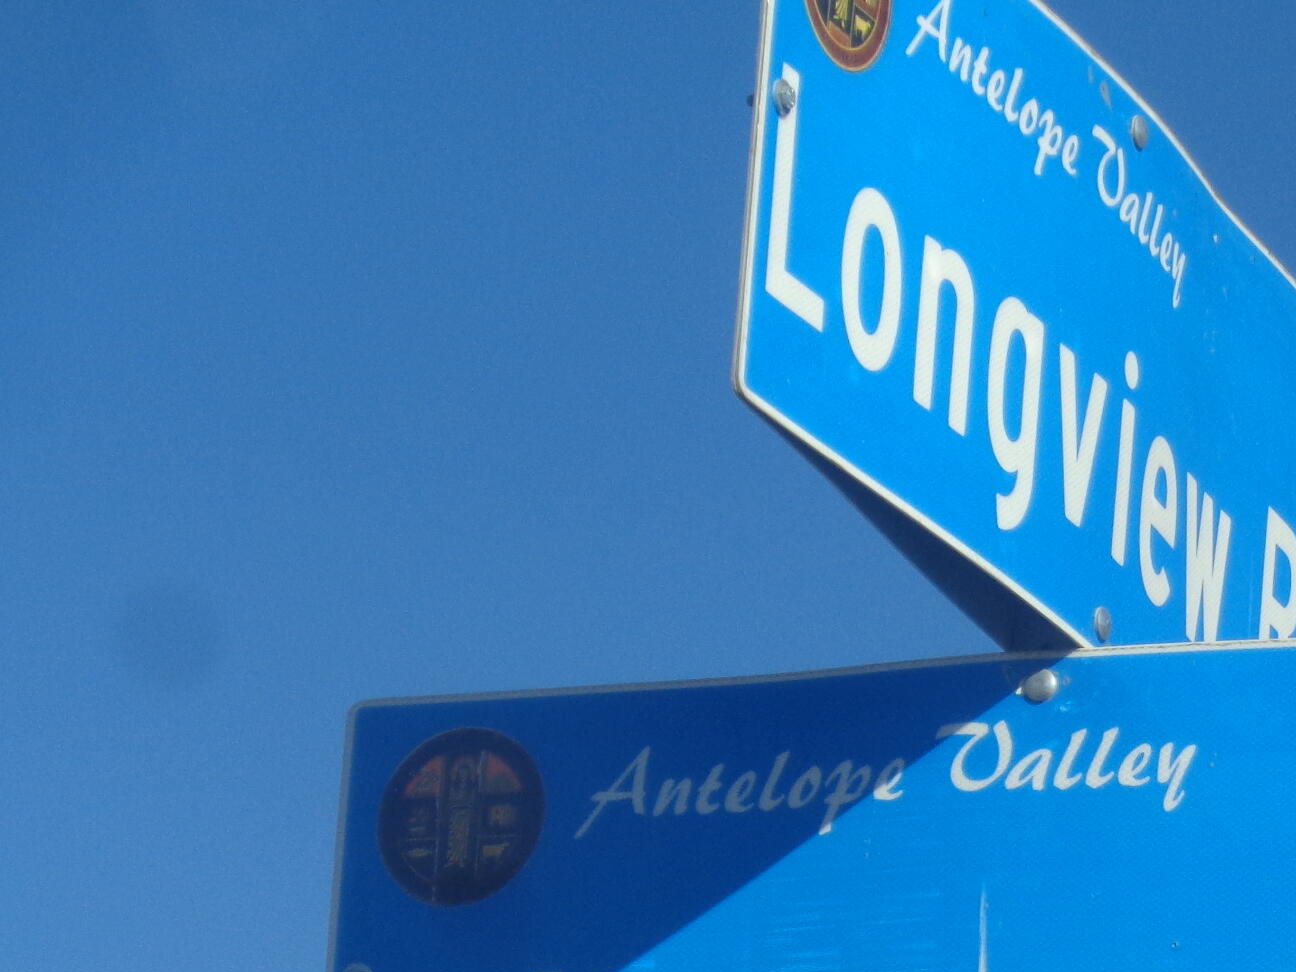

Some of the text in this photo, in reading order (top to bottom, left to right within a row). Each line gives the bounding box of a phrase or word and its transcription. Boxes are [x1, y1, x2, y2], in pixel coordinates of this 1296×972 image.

[905, 0, 1186, 309] Antelope Valley
[765, 63, 1231, 642] Longview
[575, 721, 1197, 839] Antelope Valley
